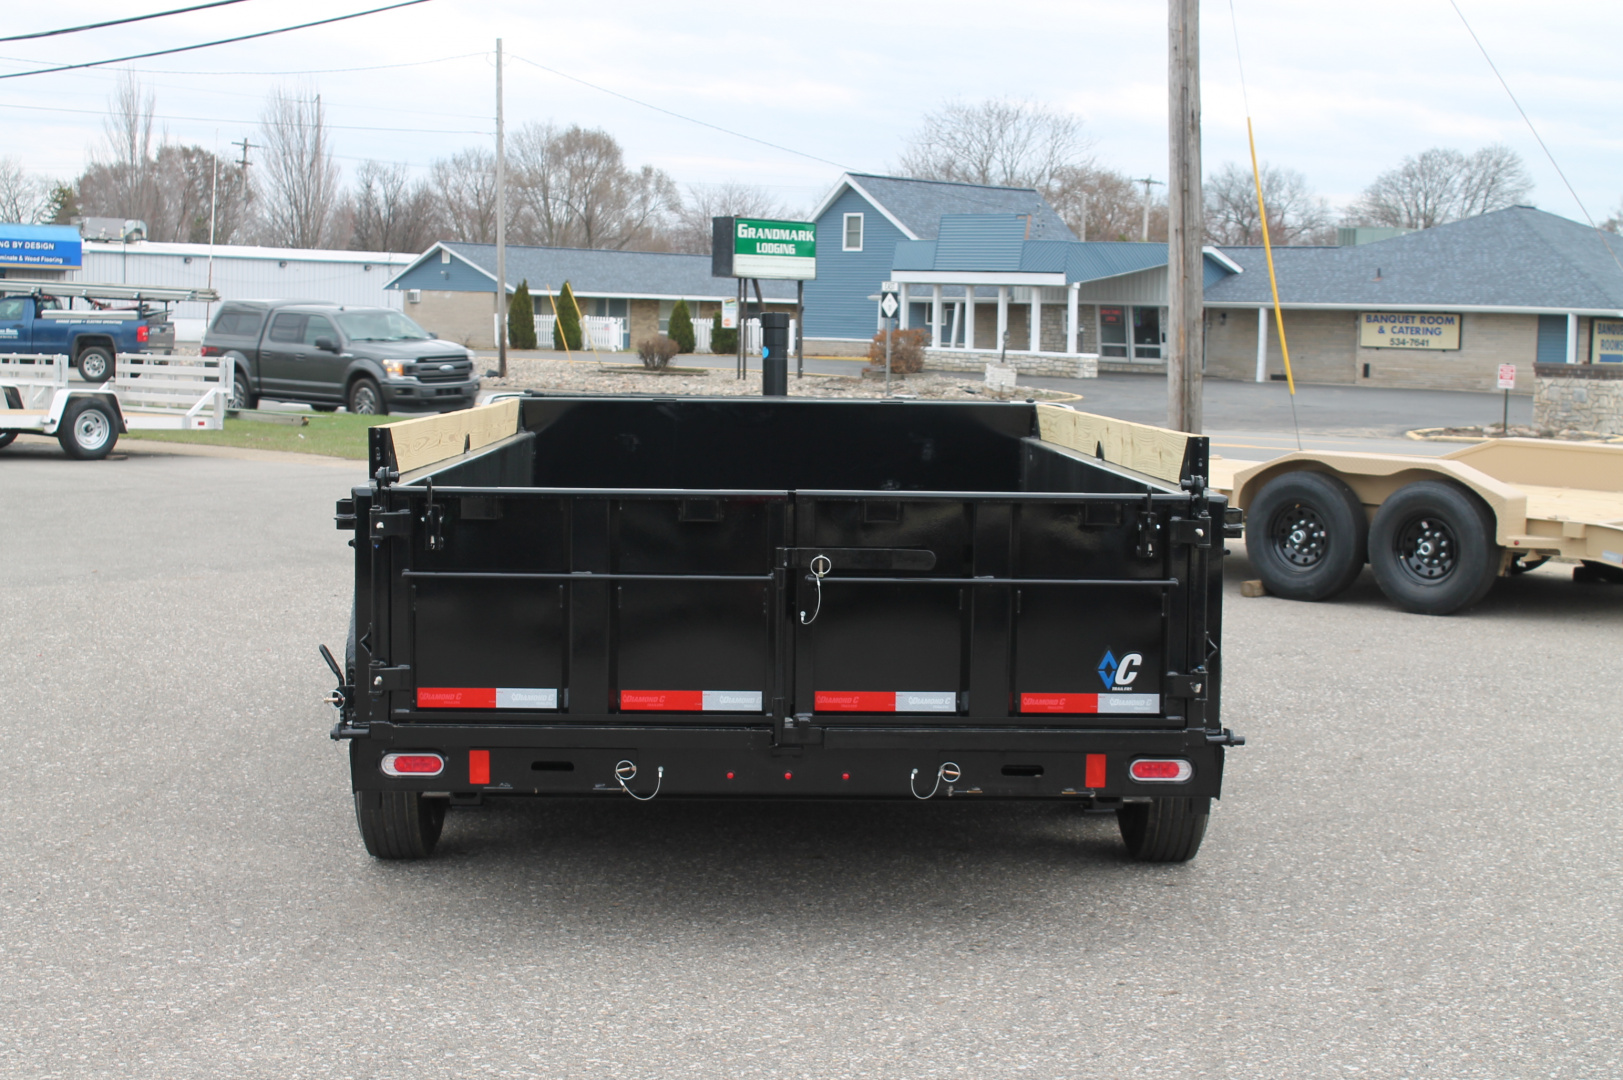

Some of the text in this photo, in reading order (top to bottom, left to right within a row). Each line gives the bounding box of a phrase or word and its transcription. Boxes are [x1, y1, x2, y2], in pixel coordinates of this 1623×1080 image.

[737, 223, 815, 242] GRANDMARK
[12, 241, 22, 249] BY
[25, 241, 55, 251] DESIGN
[756, 242, 796, 255] LODGING
[25, 255, 40, 263] Wood
[41, 256, 63, 264] Flooring
[1366, 314, 1455, 325] BANQUET ROOM
[1378, 326, 1442, 336] & CATERING
[1390, 338, 1430, 347] 534-7641
